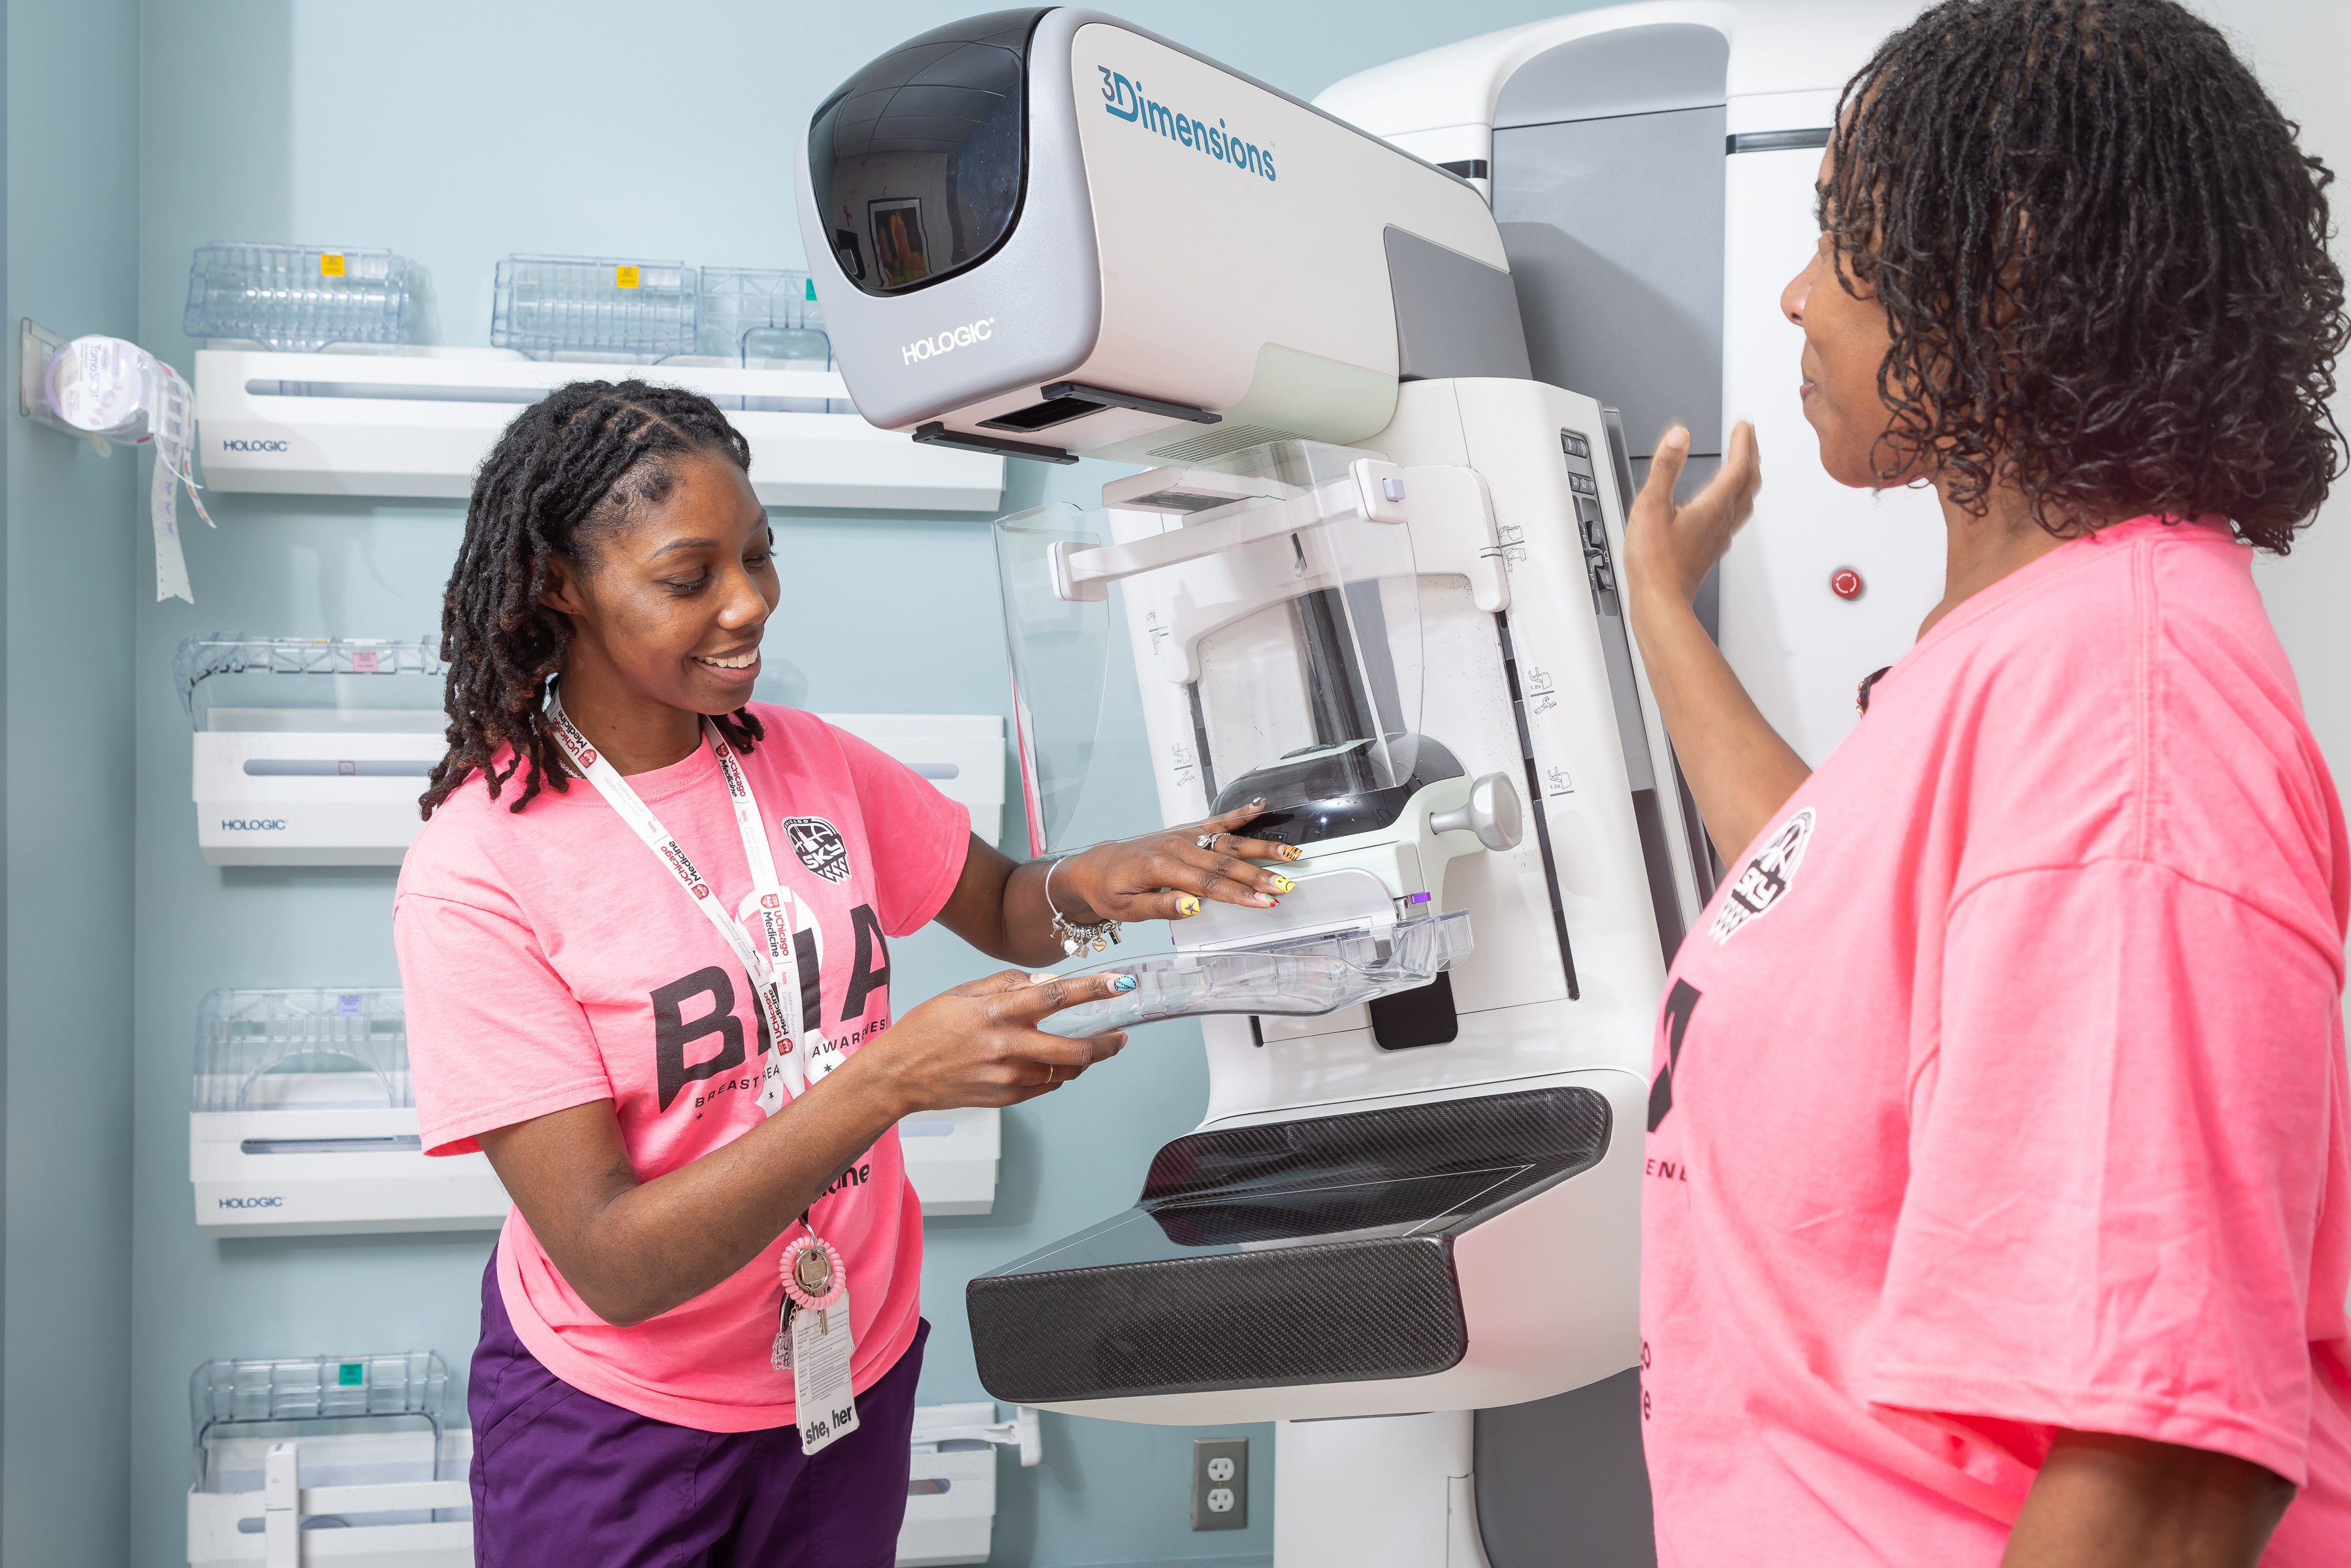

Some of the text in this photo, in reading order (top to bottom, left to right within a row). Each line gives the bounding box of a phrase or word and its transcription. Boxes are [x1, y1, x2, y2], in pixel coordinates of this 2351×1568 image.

[1098, 65, 1276, 182] 3Dimensions
[223, 440, 287, 452] HOLOGIC
[558, 709, 588, 749] Medicine
[720, 760, 737, 797] Medicine
[728, 756, 746, 797] UChicago
[222, 820, 286, 830] HOLOGIC
[661, 846, 693, 886] UChicago
[669, 840, 701, 882] Medicine
[803, 839, 844, 869] SKY
[763, 911, 779, 957] Medicine
[774, 910, 789, 956] UChicago
[763, 992, 782, 1039] UChicago
[769, 989, 789, 1036] Medicine
[695, 1076, 760, 1108] BREAST
[219, 1197, 283, 1208] HOLOGIC
[806, 1405, 852, 1445] she, her
